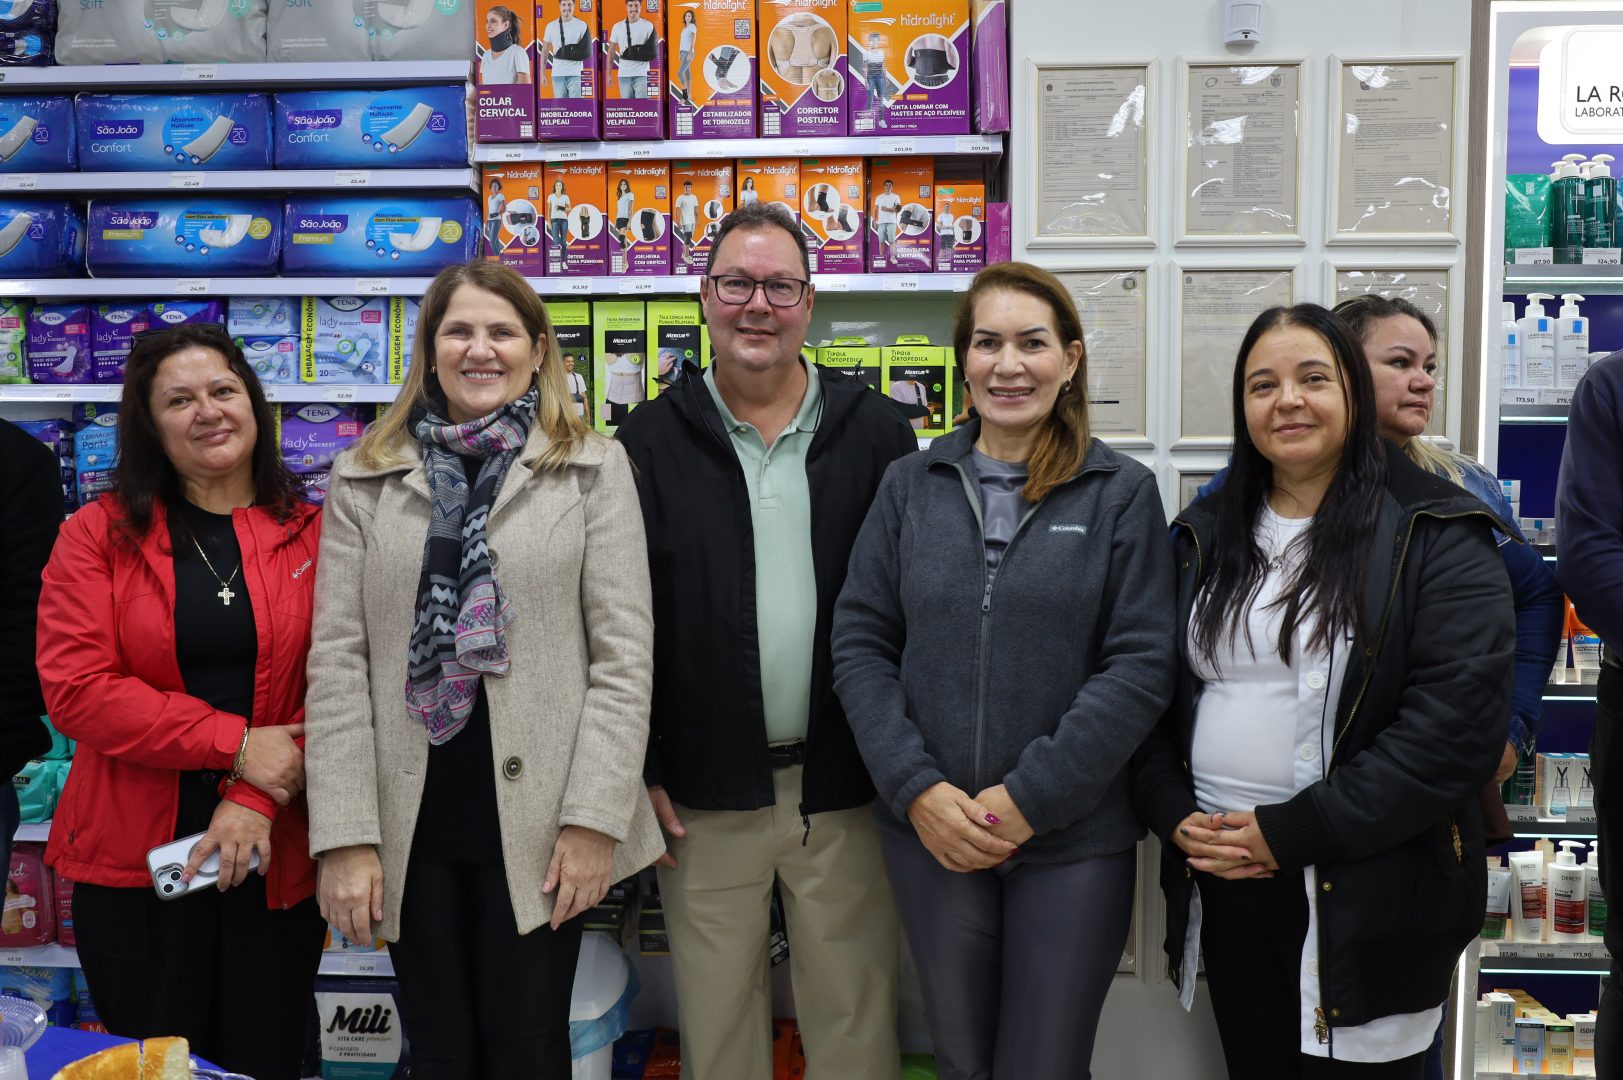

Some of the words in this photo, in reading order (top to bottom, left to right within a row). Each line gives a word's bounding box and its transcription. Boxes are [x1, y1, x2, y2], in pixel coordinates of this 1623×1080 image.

[704, 0, 746, 12] hidrolight
[900, 14, 954, 28] hidrolight
[1576, 86, 1602, 103] LA
[480, 97, 512, 106] COLAR
[480, 108, 527, 118] CERVICAL
[294, 115, 312, 125] São
[312, 114, 336, 124] João
[432, 118, 446, 128] 20
[96, 126, 115, 134] São
[115, 125, 138, 134] João
[36, 130, 49, 140] 20
[232, 130, 246, 140] 20
[288, 134, 330, 144] Confort
[91, 143, 132, 154] Confort
[507, 170, 538, 179] hidrolight
[570, 166, 602, 175] hidrolight
[634, 166, 666, 176] hidrolight
[698, 168, 730, 177] hidrolight
[764, 166, 796, 175] hidrolight
[827, 165, 860, 175] hidrolight
[110, 216, 128, 225] São
[129, 216, 152, 225] João
[300, 220, 318, 229] São
[318, 220, 341, 229] João
[252, 223, 267, 234] 20
[444, 227, 459, 237] 20
[319, 316, 338, 329] lady
[31, 334, 47, 344] lady
[96, 332, 112, 343] lady
[82, 440, 108, 450] Pants
[285, 437, 308, 451] lady
[326, 1004, 392, 1034] Mili
